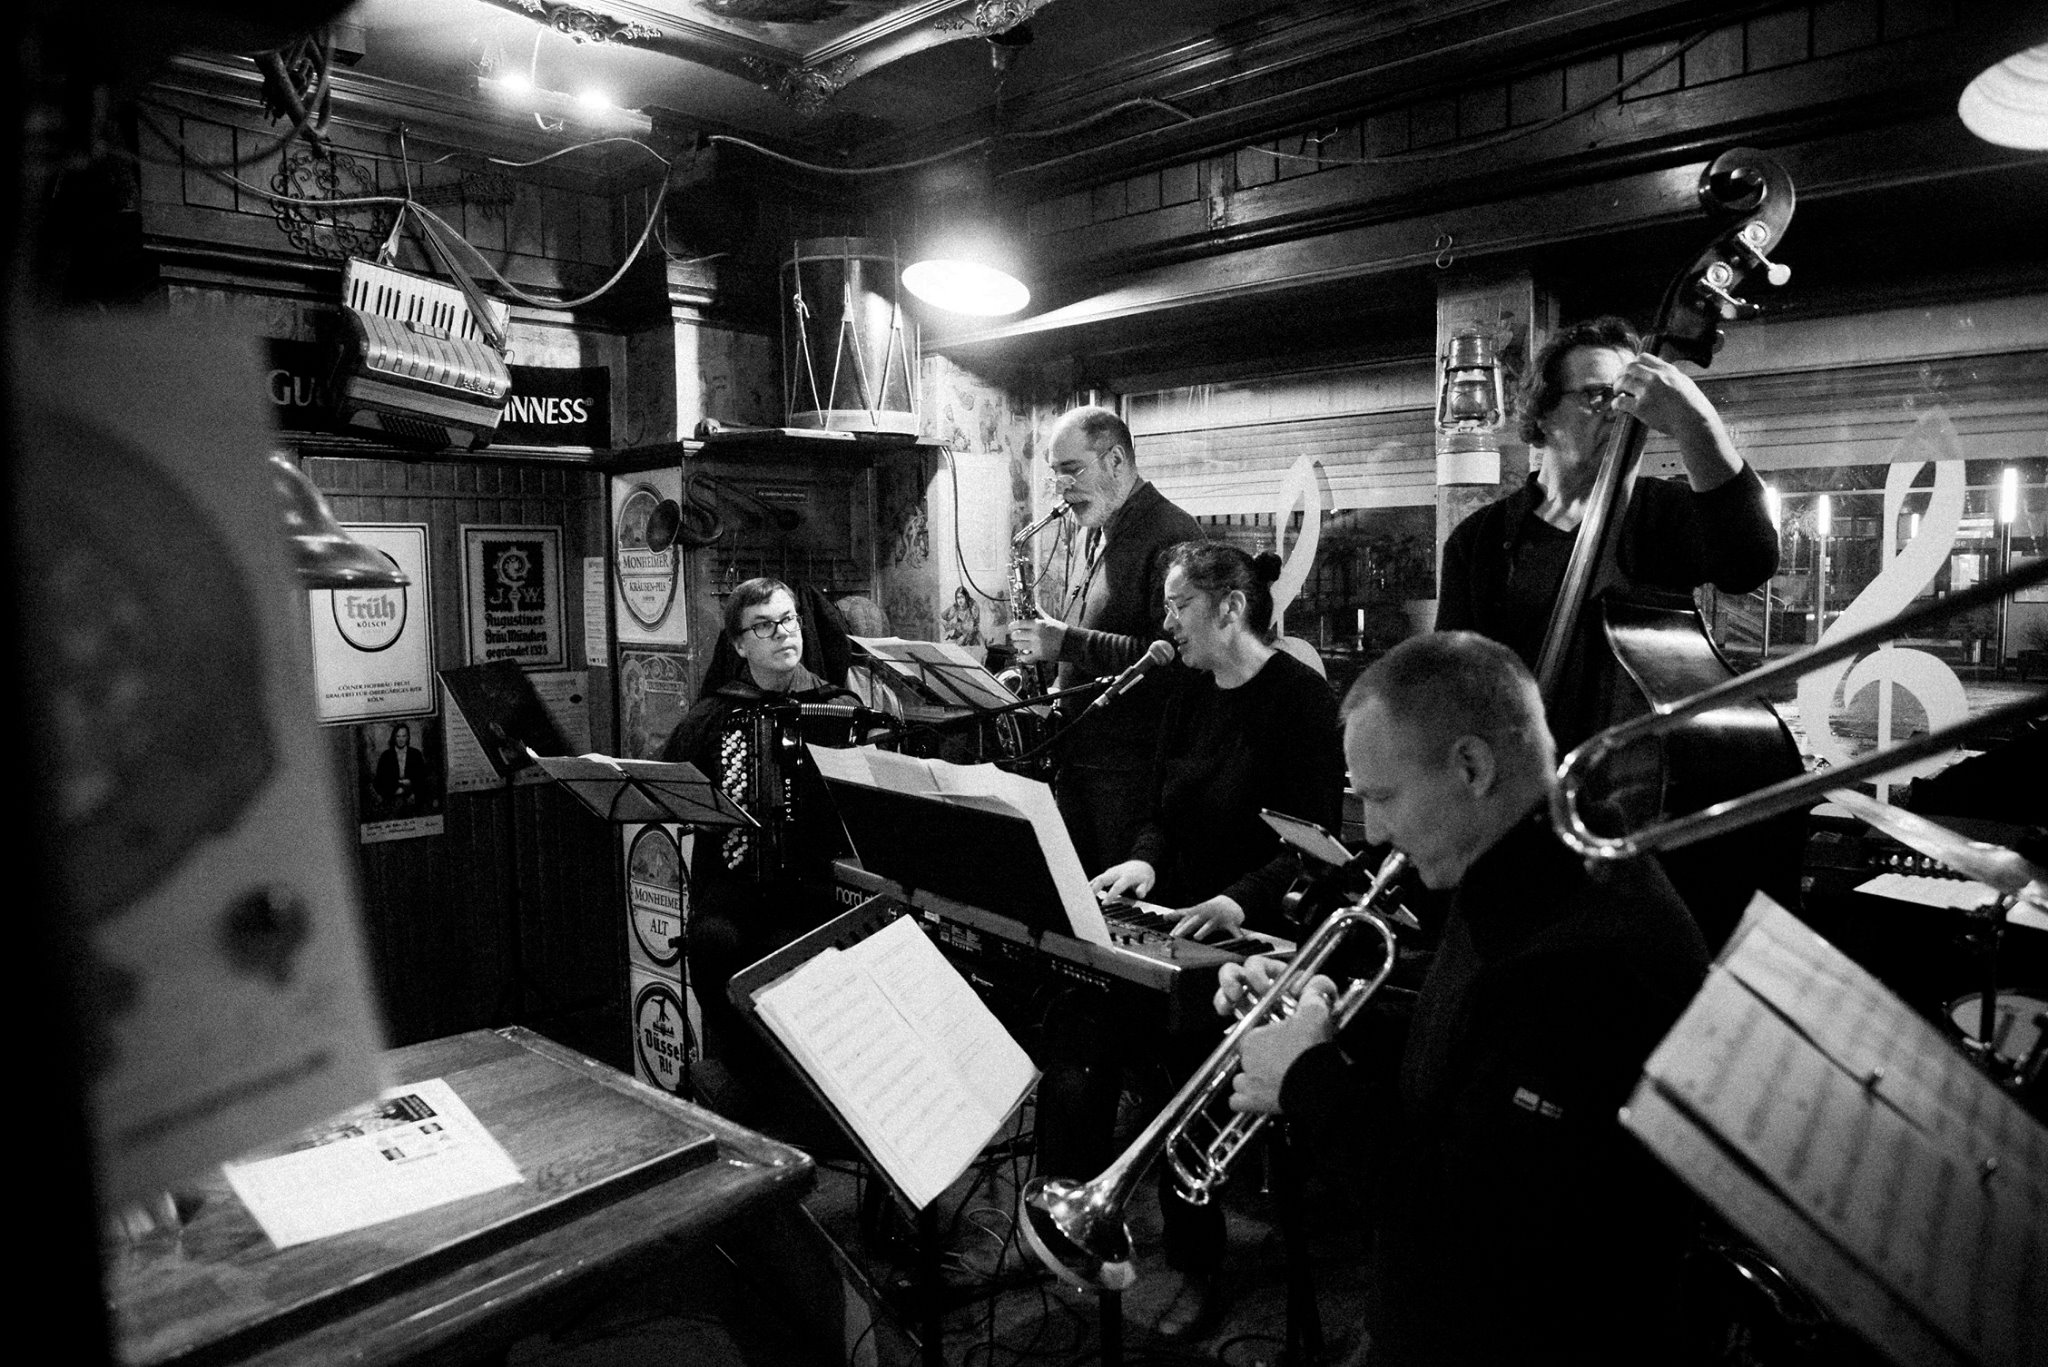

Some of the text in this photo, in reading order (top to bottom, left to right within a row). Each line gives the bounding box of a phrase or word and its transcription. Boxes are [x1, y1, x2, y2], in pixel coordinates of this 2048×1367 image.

[622, 554, 670, 569] MONHEIMER
[650, 918, 669, 936] ALT
[644, 1028, 685, 1062] Düssel
[658, 1054, 673, 1076] Alt
